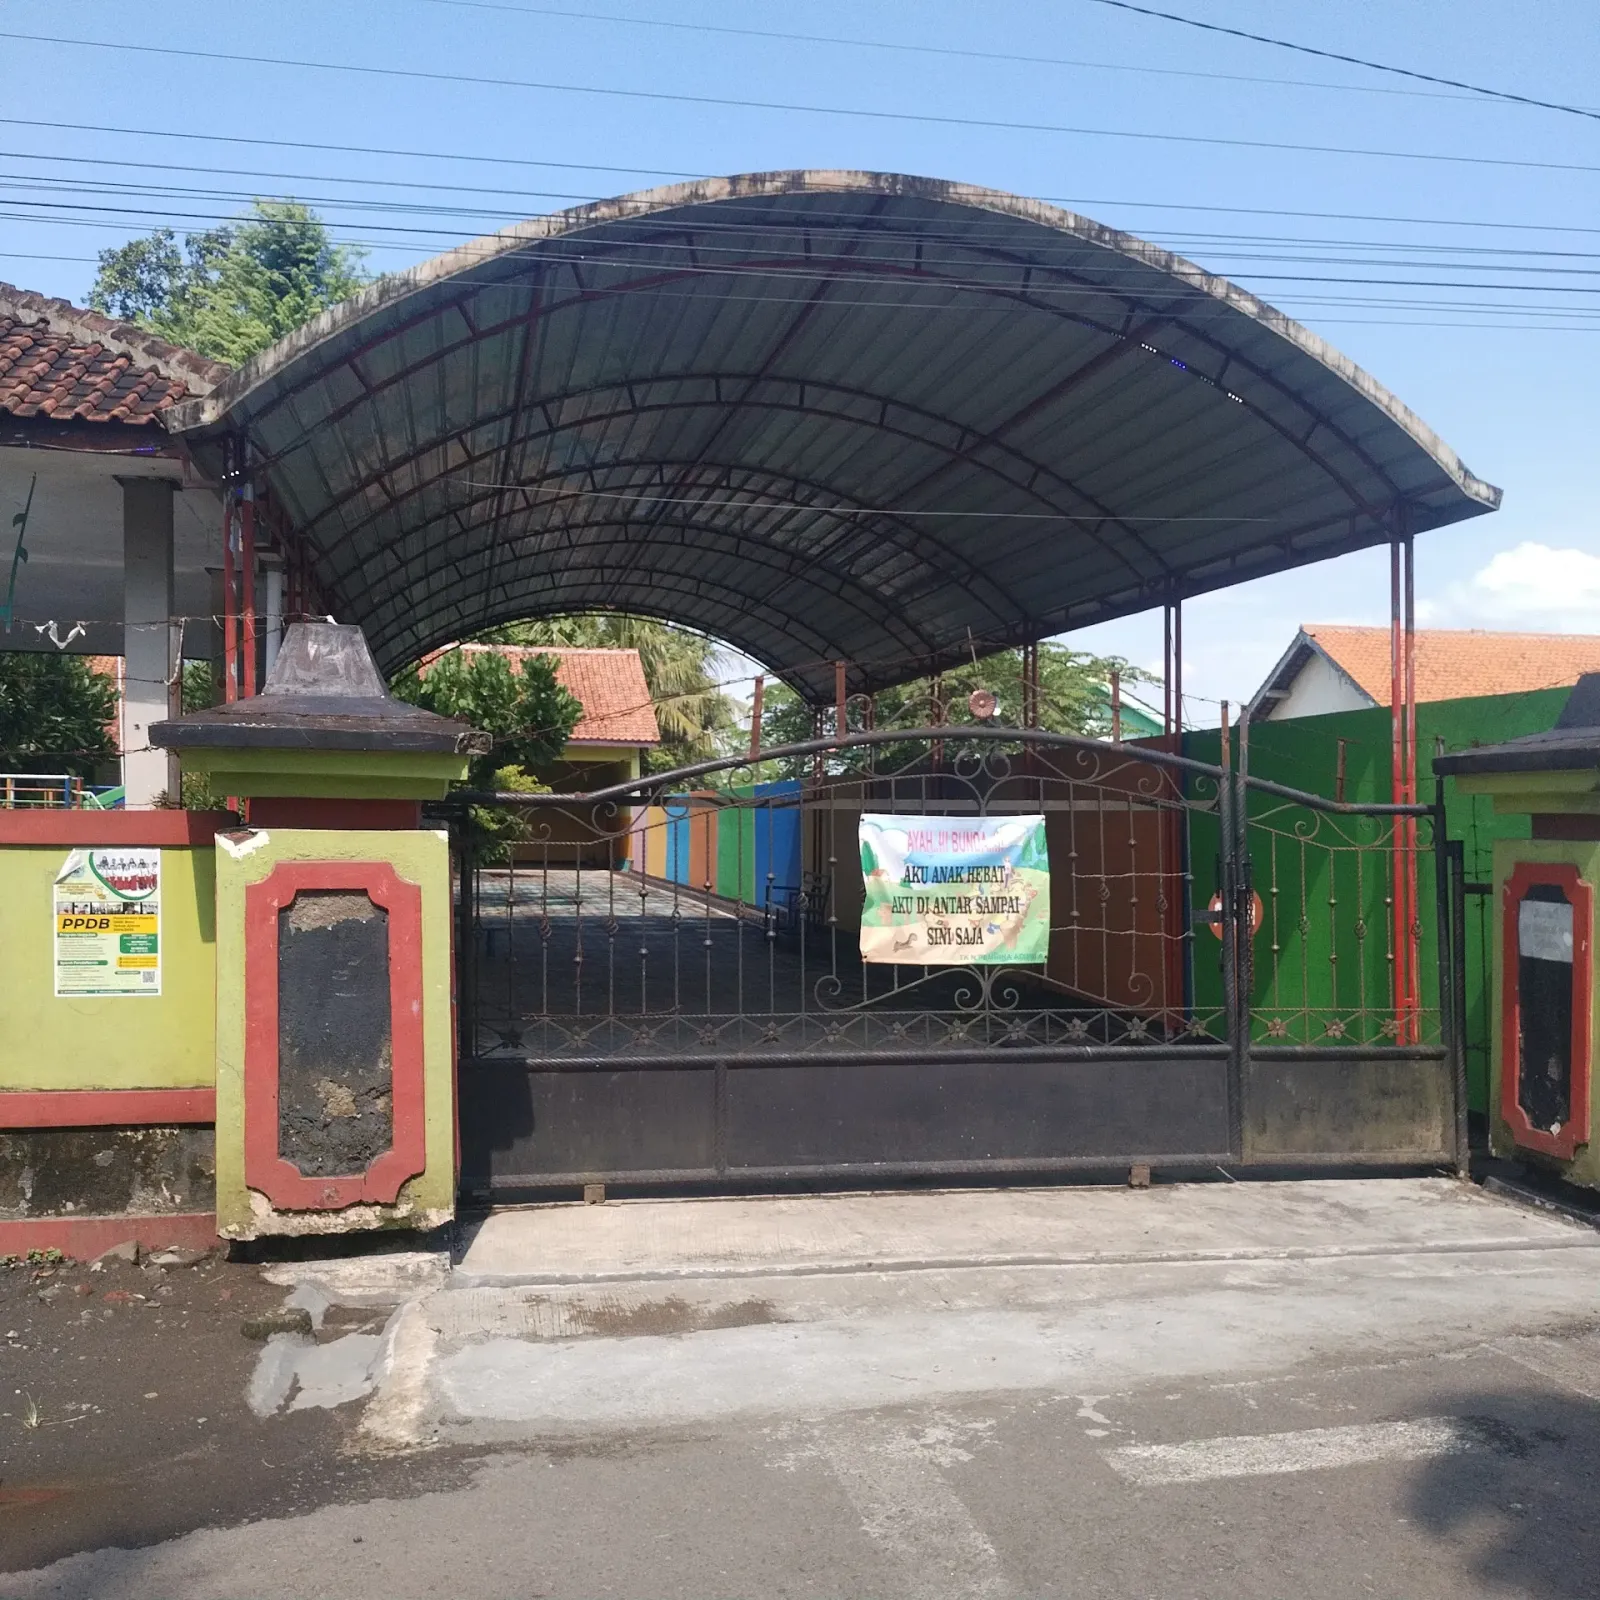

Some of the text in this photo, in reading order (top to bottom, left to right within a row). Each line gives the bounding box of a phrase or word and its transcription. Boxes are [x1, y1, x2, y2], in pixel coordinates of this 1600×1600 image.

[904, 866, 1006, 883] AKU ANAK HEBAT
[892, 896, 1020, 914] AKU DI ANTAR SAMPAI
[62, 918, 110, 929] PPDB
[927, 927, 984, 945] SINI SAJA
